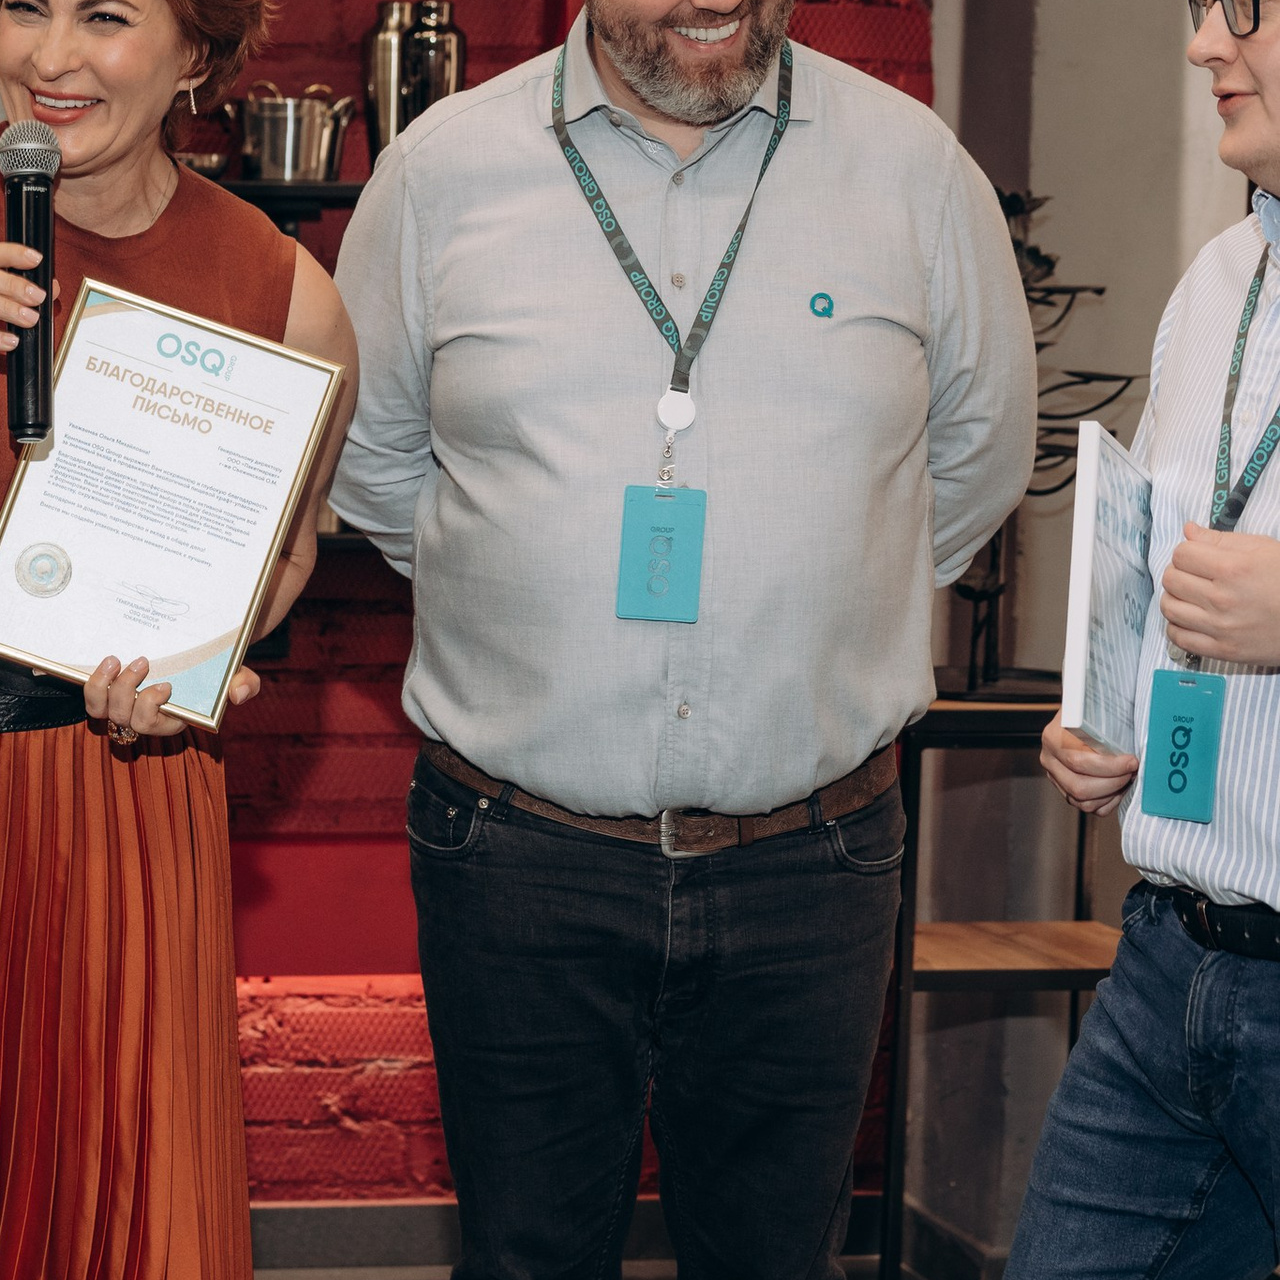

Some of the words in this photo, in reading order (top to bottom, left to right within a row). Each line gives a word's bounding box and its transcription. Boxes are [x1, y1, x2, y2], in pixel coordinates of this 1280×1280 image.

[776, 100, 790, 132] OSQ
[564, 146, 598, 197] GROUP
[592, 197, 616, 232] OSQ
[721, 231, 742, 264] OSQ
[630, 270, 667, 320] GROUP
[700, 268, 728, 322] GROUP
[810, 292, 834, 319] Q
[1230, 334, 1246, 375] OSQ
[1239, 277, 1261, 334] GROUP
[156, 333, 225, 377] OSQ
[224, 355, 238, 383] GROUP
[85, 356, 275, 436] БЛАГОДАРСТВЕННОЕ
[132, 394, 213, 435] ПИСЬМО
[91, 442, 105, 451] OSQ
[104, 447, 123, 459] Group
[1216, 423, 1230, 483] GROUP
[1243, 424, 1280, 487] GROUP
[647, 535, 674, 598] OSQ
[1172, 715, 1194, 724] GROUP
[1168, 725, 1193, 794] OSQ
